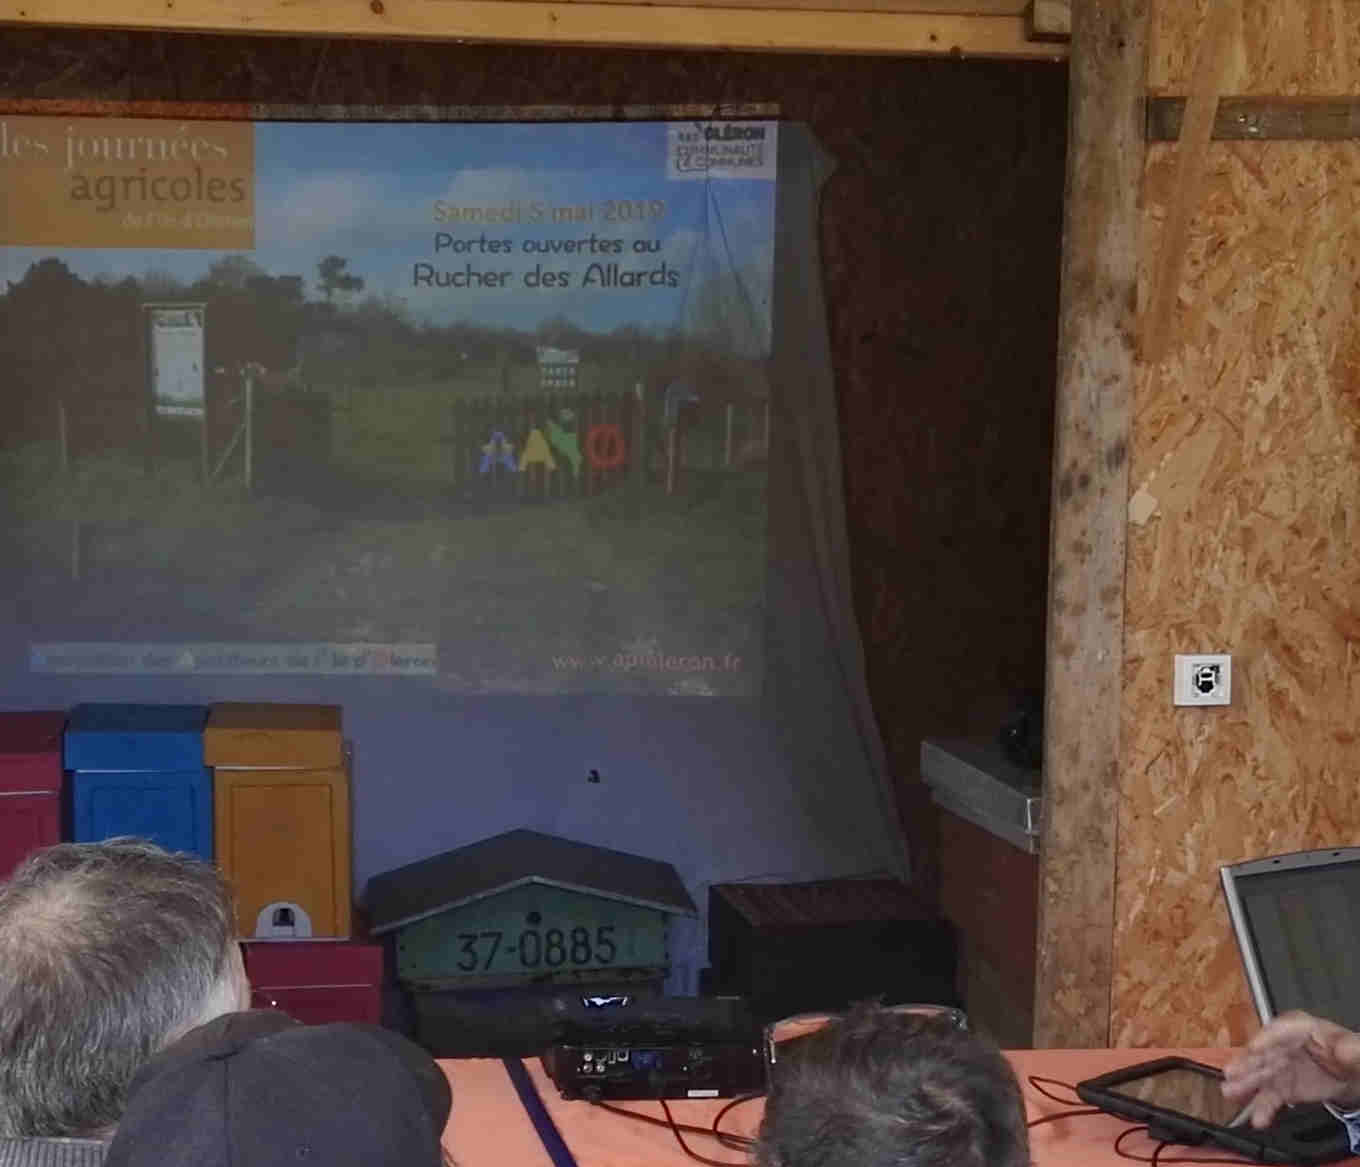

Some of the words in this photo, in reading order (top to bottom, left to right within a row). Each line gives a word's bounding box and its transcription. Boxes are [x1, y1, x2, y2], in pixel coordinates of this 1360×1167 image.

[70, 166, 248, 214] agricoles
[433, 199, 521, 223] Samedi
[551, 200, 593, 222] mai
[601, 199, 666, 222] 2019
[434, 231, 513, 254] Portes
[521, 231, 625, 254] ouvertes
[632, 236, 662, 254] au
[412, 262, 513, 289] Rucher
[523, 262, 571, 289] des
[581, 260, 682, 290] Allards
[456, 925, 617, 971] 37-0885
